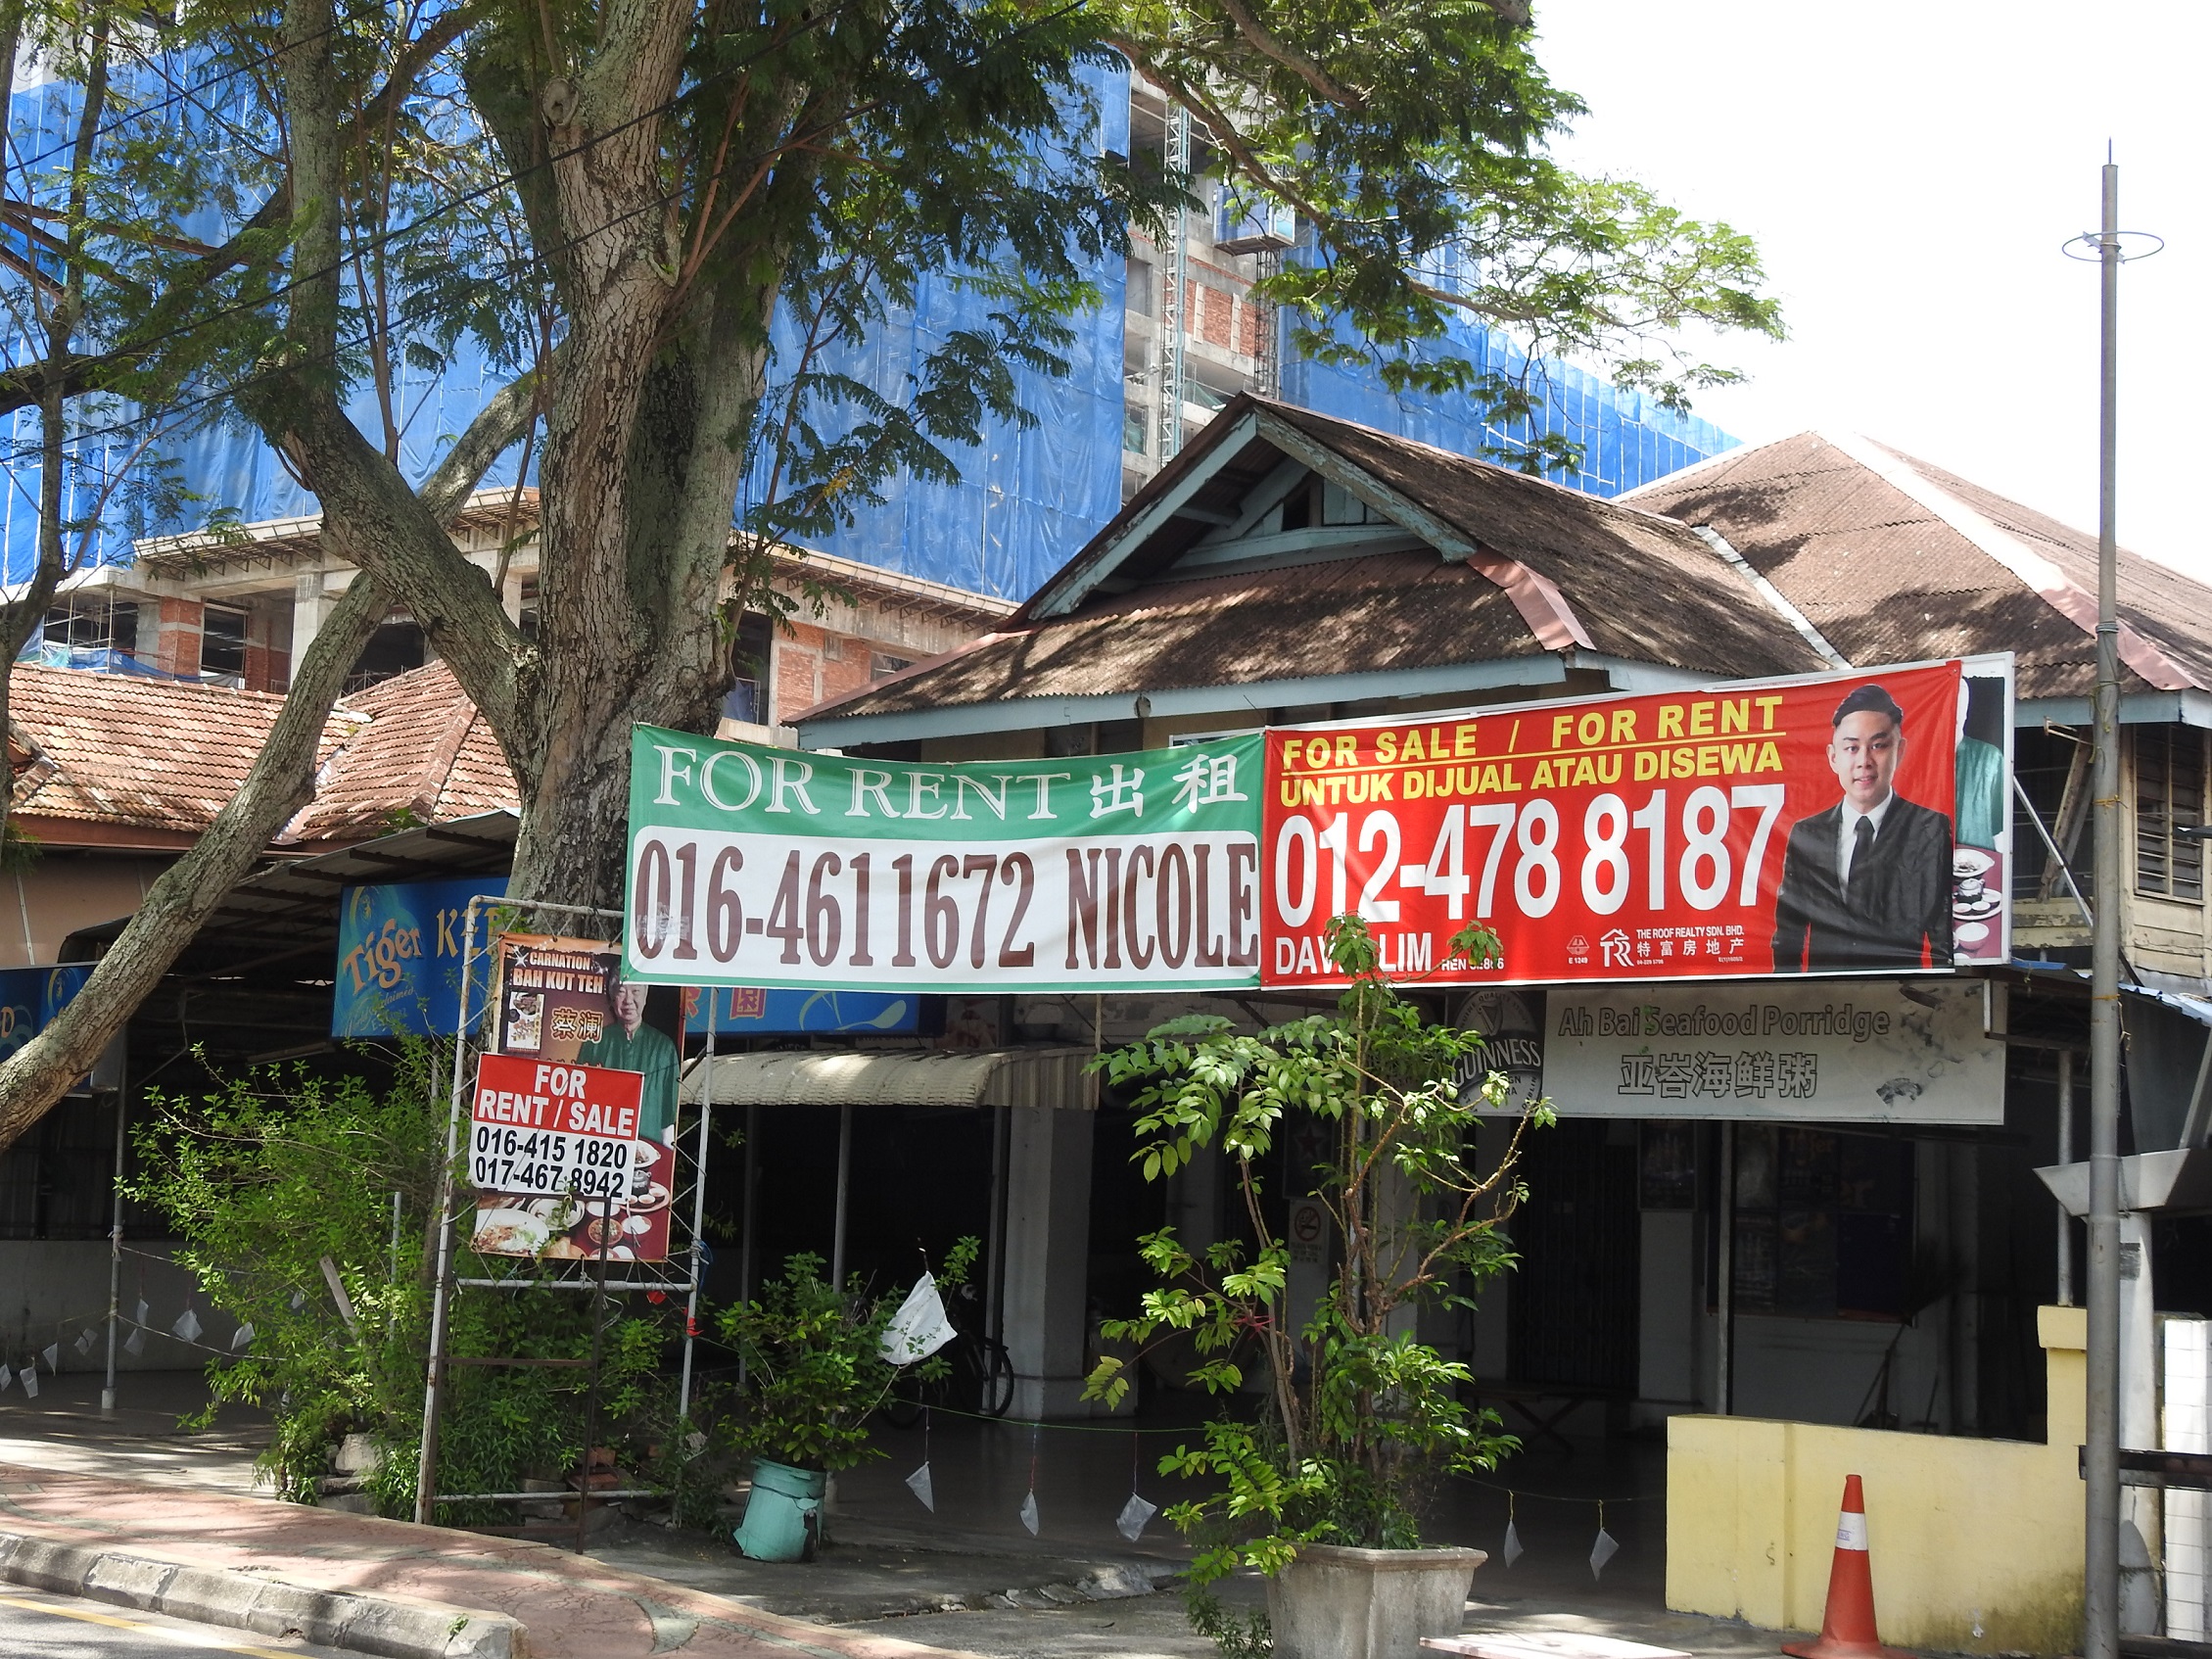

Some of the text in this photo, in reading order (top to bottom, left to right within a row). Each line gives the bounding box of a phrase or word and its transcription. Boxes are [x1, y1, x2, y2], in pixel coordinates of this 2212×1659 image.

[1284, 695, 1783, 770] FOR SALE / FOR RENT
[653, 744, 1071, 822] FOR RENT
[1088, 753, 1249, 820] 出租
[1280, 741, 1783, 808] UNTUK DIJUAL ATAU DISEWA
[1275, 783, 1785, 928] 012-478 8187
[1064, 842, 1258, 971] NICOLE
[1275, 935, 1372, 975] DAV
[1379, 931, 1433, 972] LIM
[1636, 924, 1745, 939] THE ROOF REALTY SDN. BHD.
[1636, 937, 1744, 958] 特富房地产
[342, 918, 422, 996] Tiger
[529, 951, 591, 972] CARNATION
[512, 968, 604, 995] BAH KUT TEH
[550, 1006, 604, 1043] 蔡澜
[1558, 1003, 1891, 1043] Ah Bai Seafood Porridge
[534, 1064, 587, 1099] FOR
[1451, 1038, 1541, 1088] GUINNESS
[478, 1088, 635, 1137] RENT / SALE
[477, 1126, 628, 1169] 016-415 1820
[475, 1156, 625, 1199] 017-467 8942
